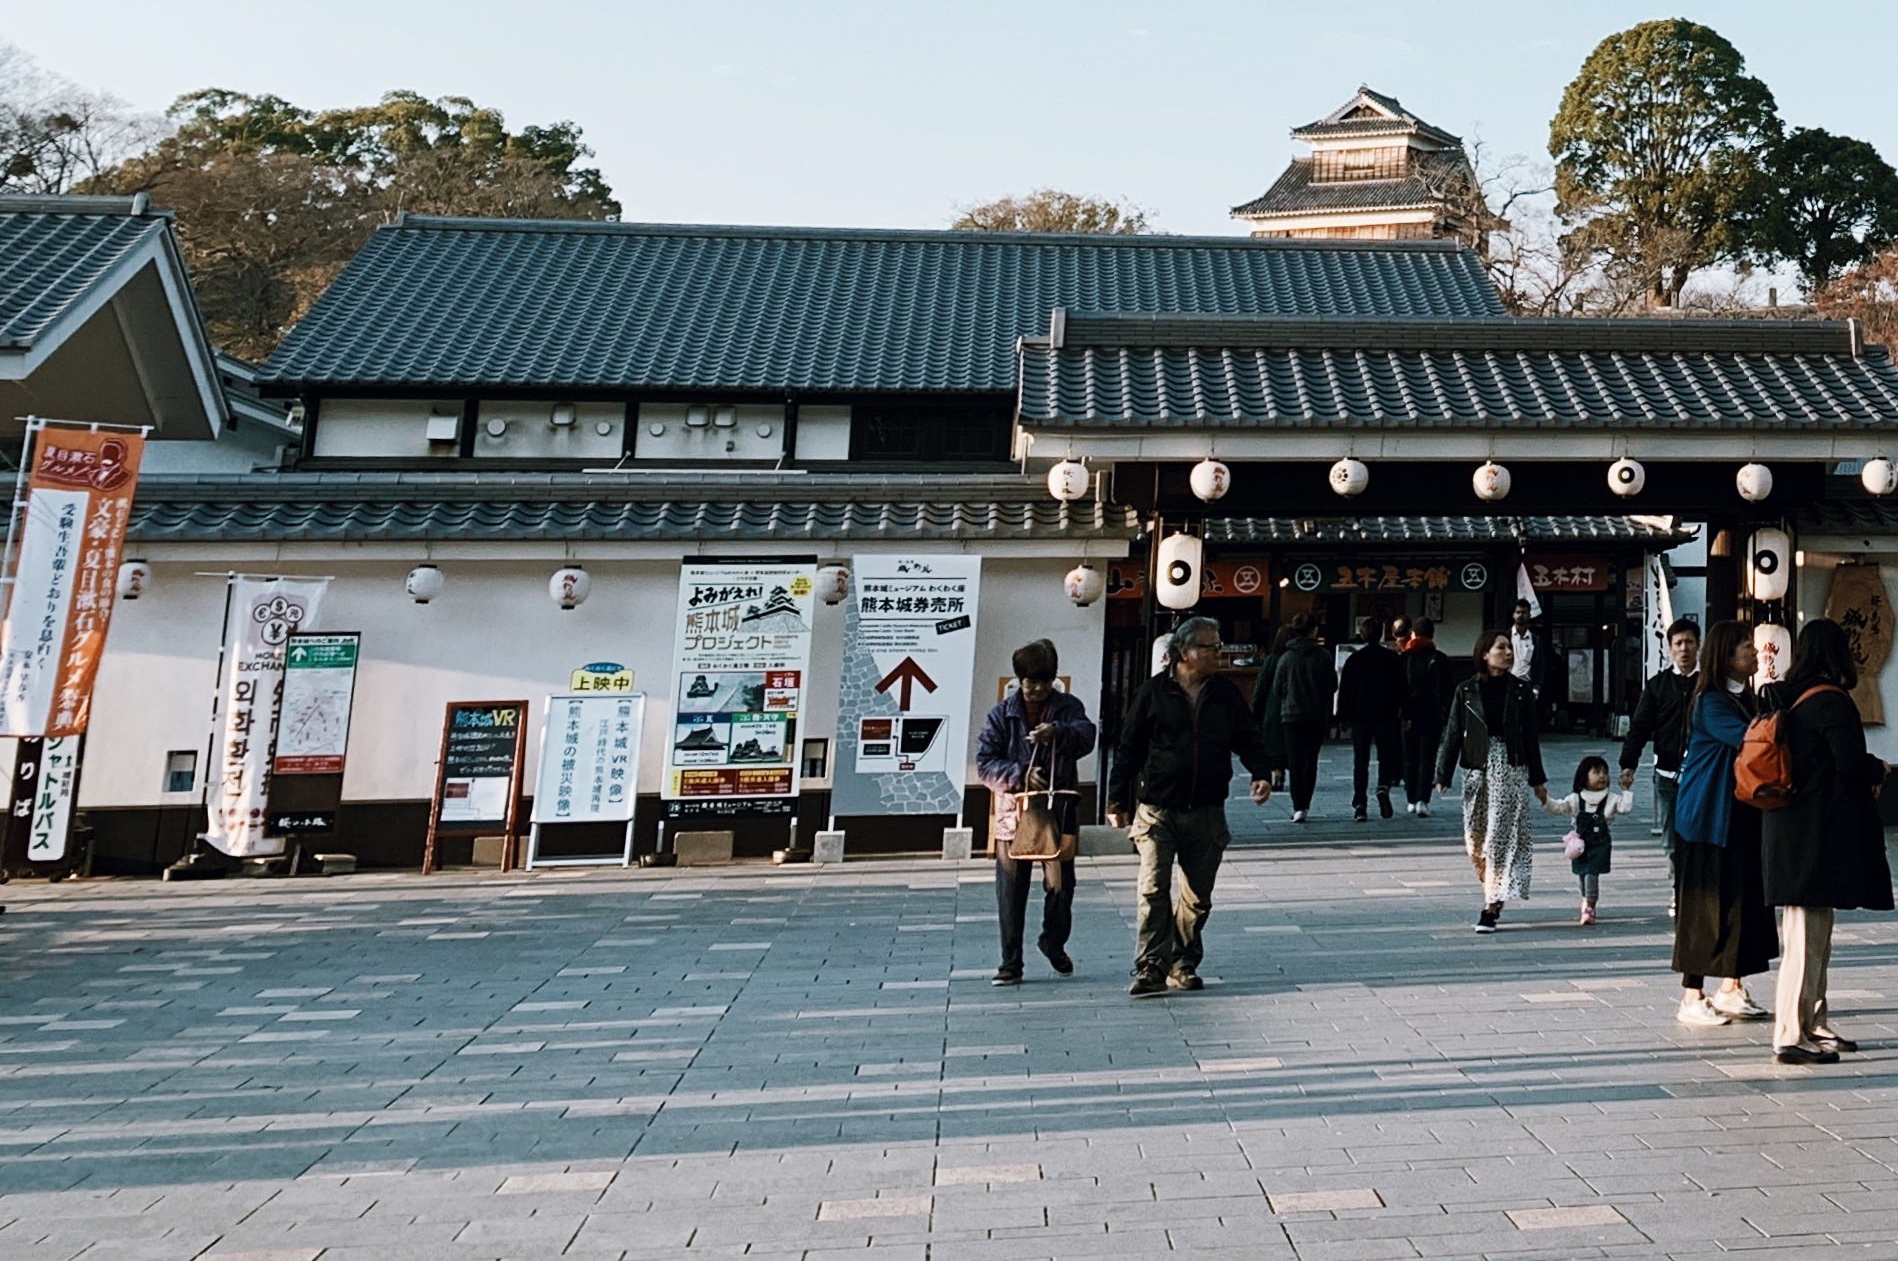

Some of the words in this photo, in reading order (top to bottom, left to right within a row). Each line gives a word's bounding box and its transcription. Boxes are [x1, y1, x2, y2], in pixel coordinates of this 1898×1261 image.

[44, 446, 96, 463] 夏目漱石
[1532, 564, 1596, 587] 五木村
[863, 585, 926, 593] 熊本城ミュージアム
[861, 597, 964, 614] 熊本城券売所
[685, 604, 741, 634] 熊本城
[684, 634, 772, 651] プロジェクト
[573, 676, 630, 691] 上映中
